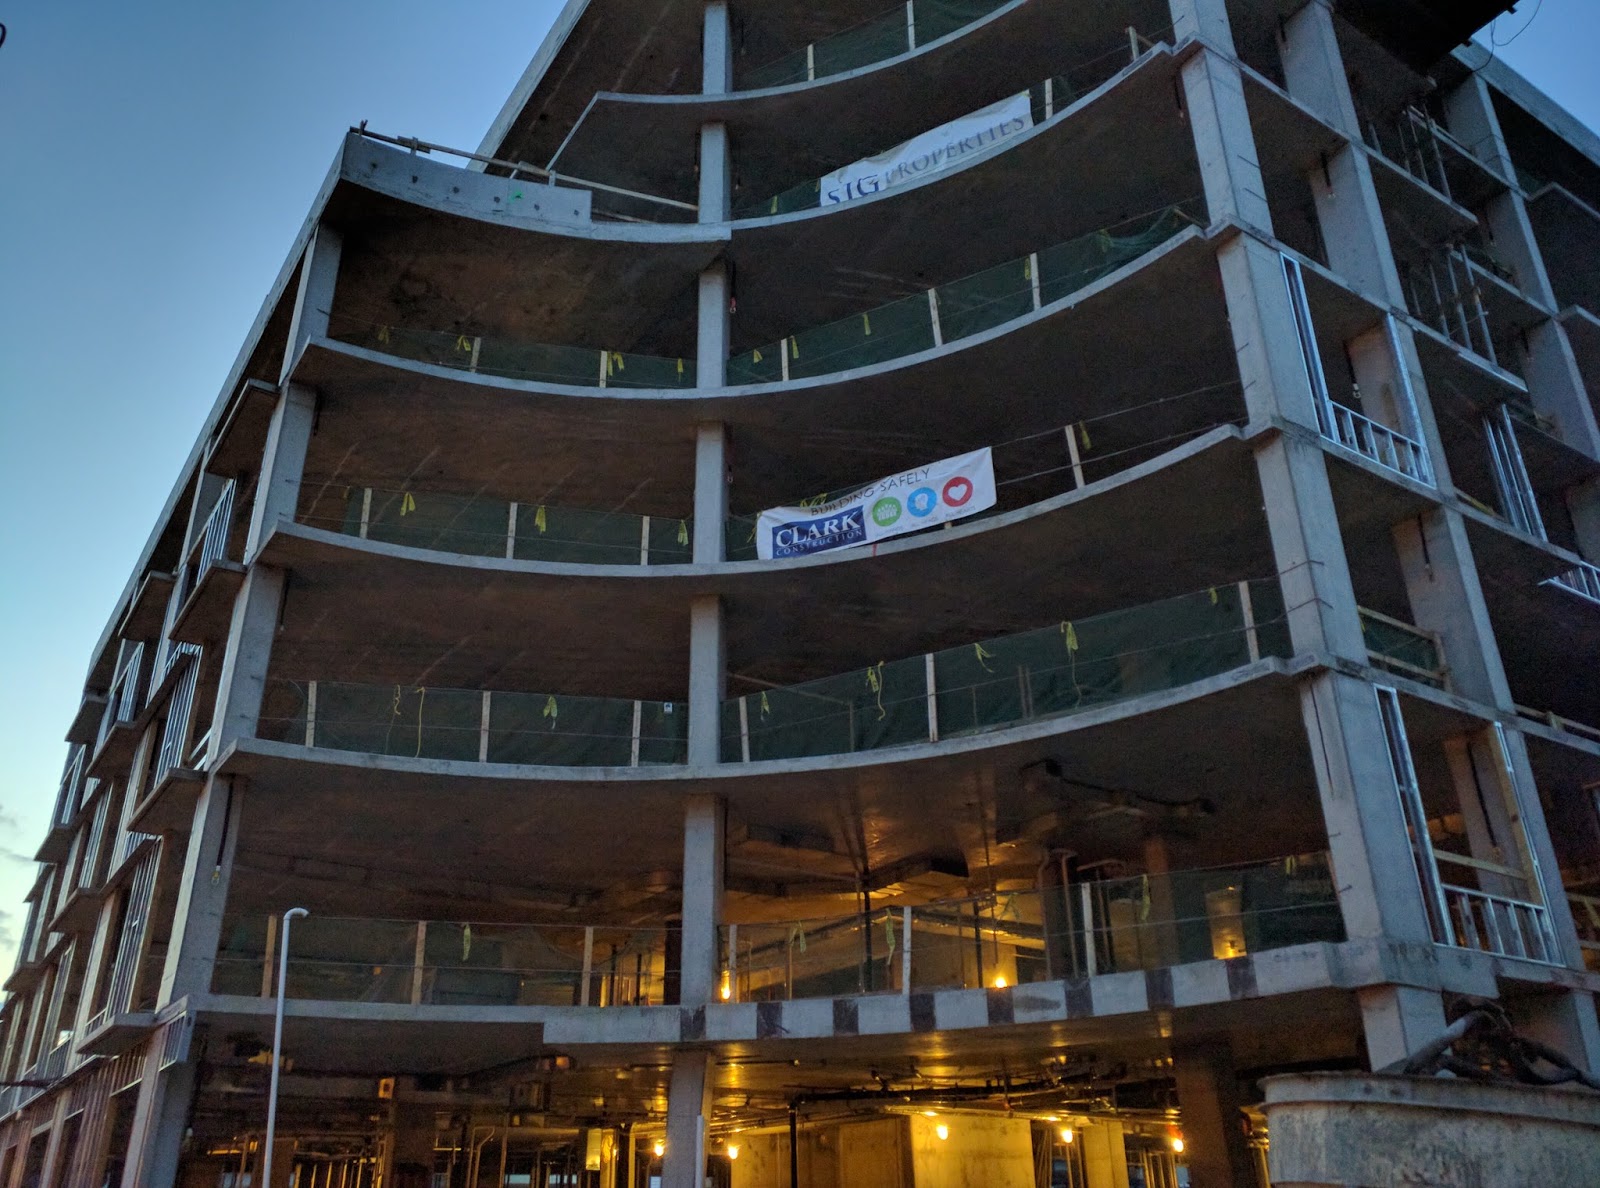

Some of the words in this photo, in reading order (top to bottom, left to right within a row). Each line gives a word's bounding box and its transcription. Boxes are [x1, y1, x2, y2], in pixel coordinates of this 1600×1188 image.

[811, 487, 875, 516] BUILDING
[880, 467, 930, 493] SAFELY
[776, 510, 861, 547] CLARK
[776, 529, 863, 556] CONSTRUCTION
